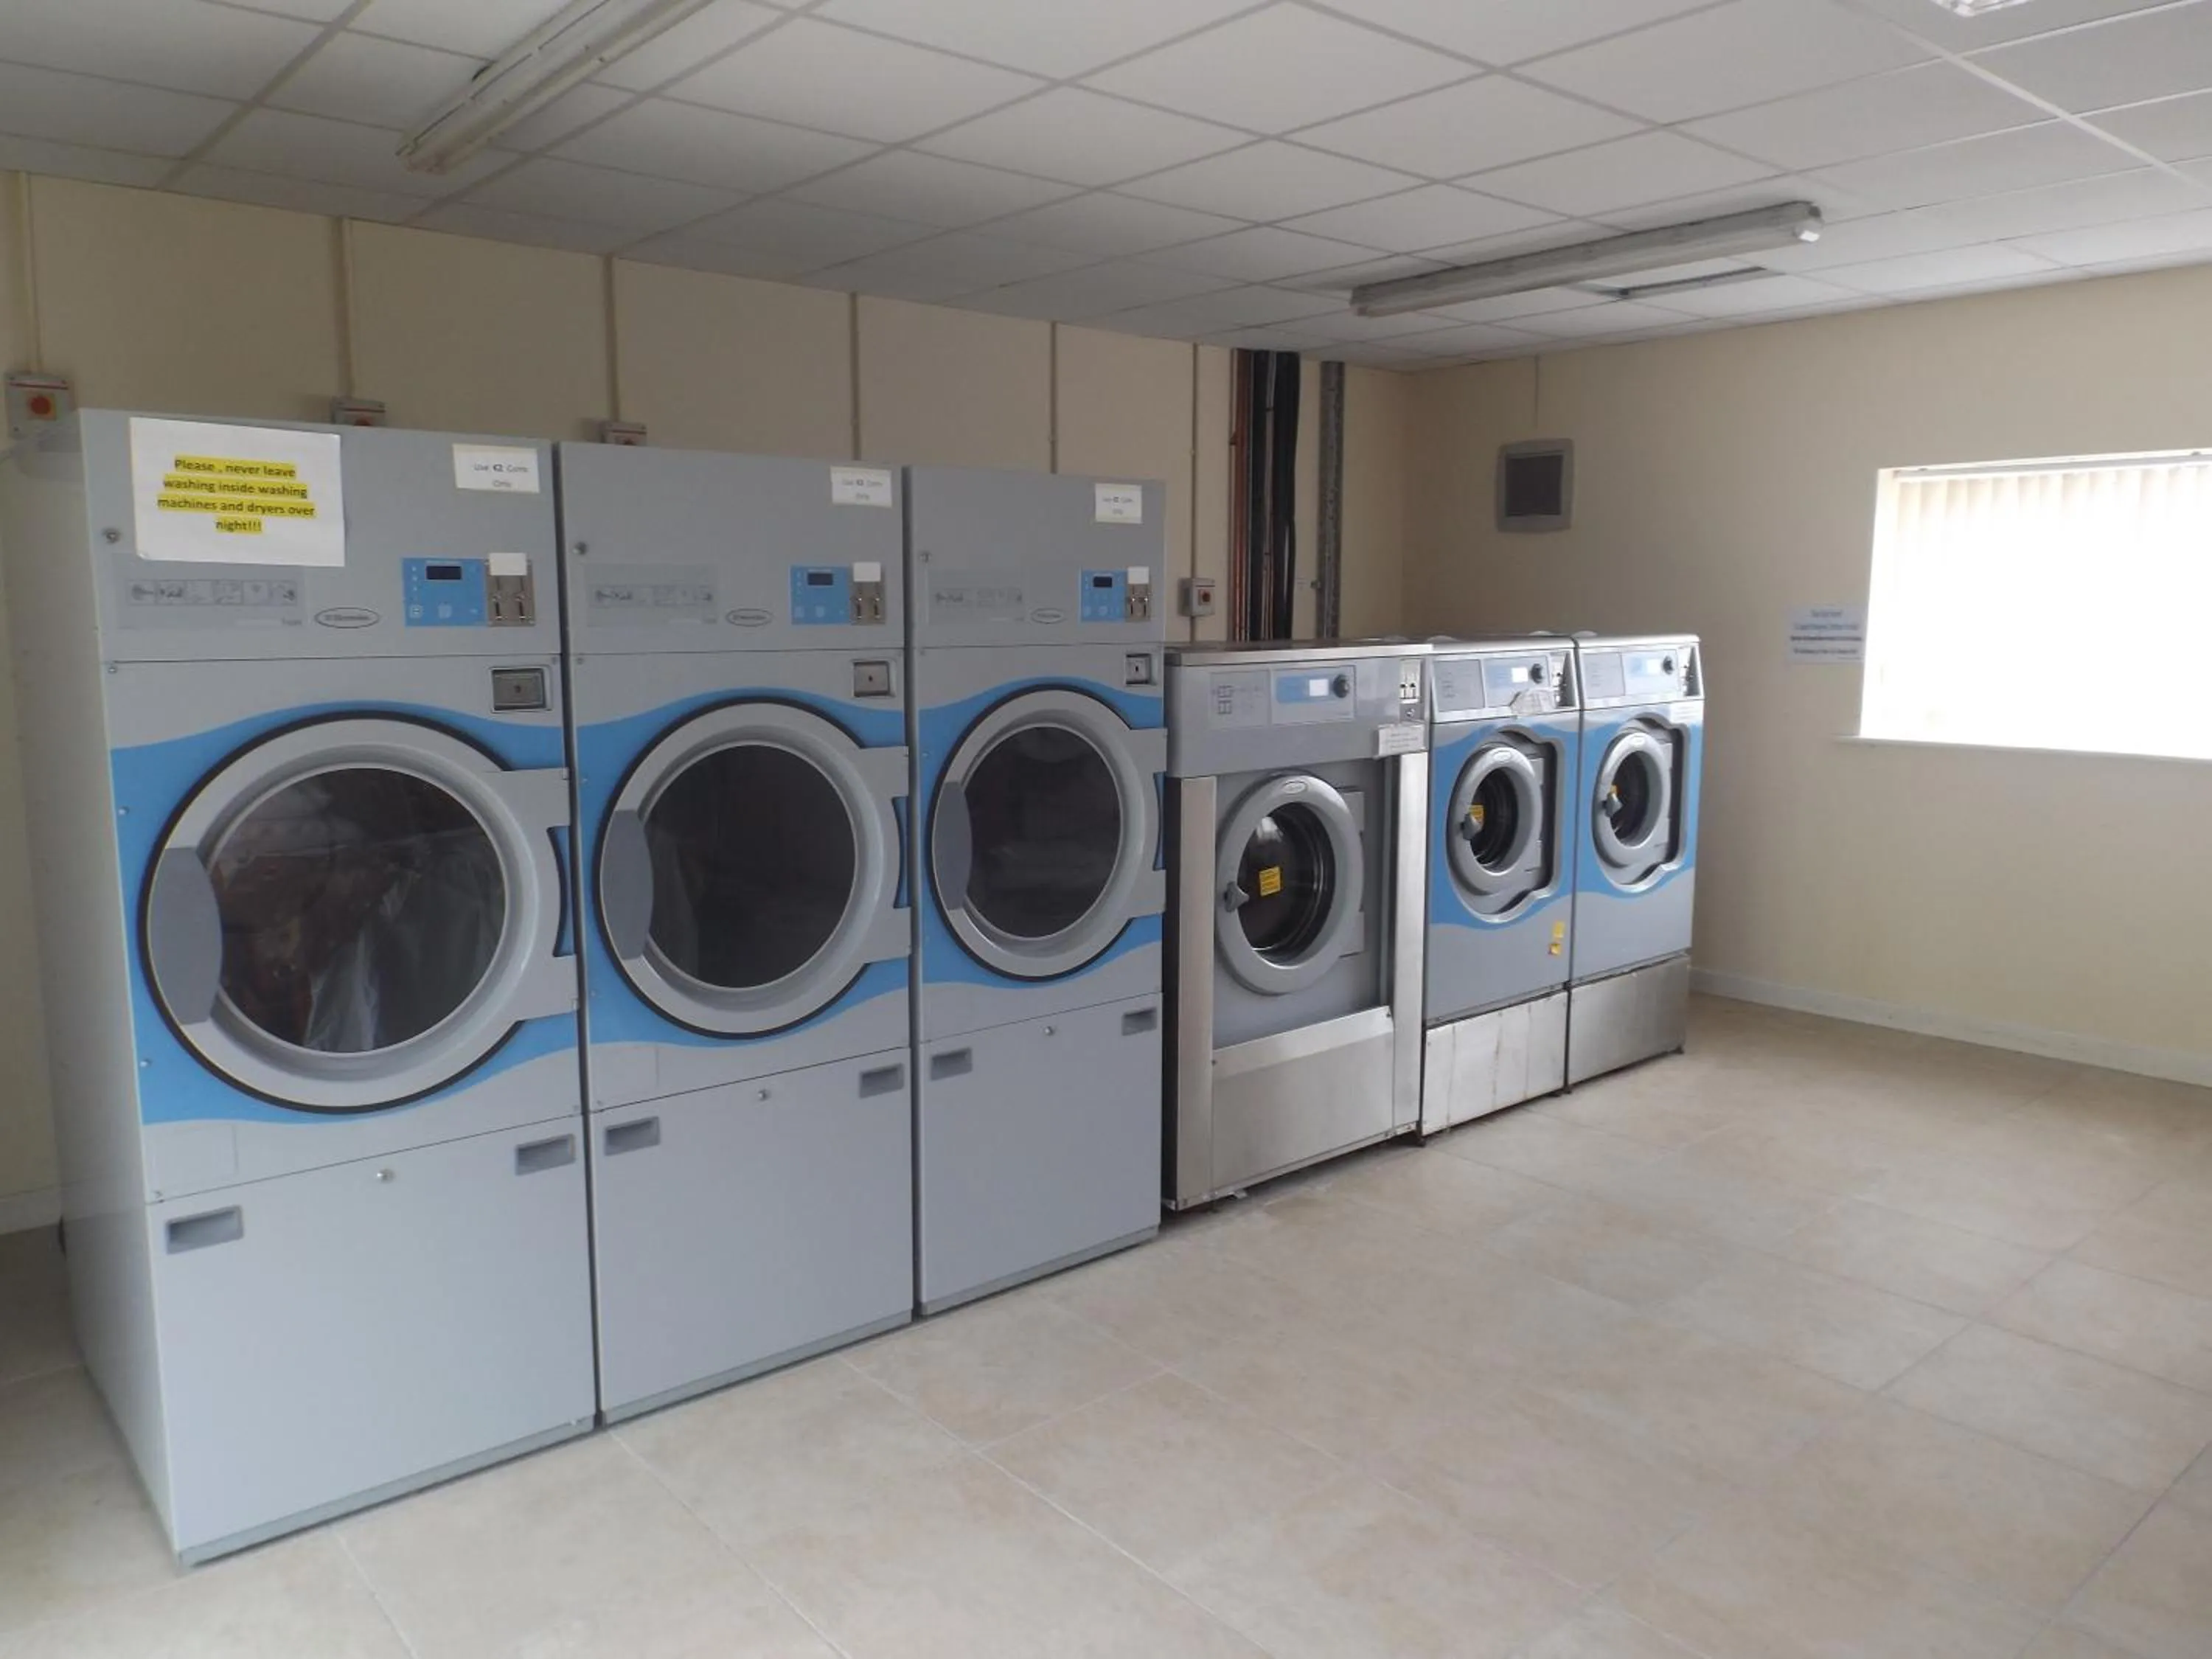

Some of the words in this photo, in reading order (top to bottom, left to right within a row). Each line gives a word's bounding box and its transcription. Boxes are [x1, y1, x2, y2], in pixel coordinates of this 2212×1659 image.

[174, 459, 215, 470] Please
[225, 465, 260, 474] never
[263, 465, 296, 477] leave
[163, 479, 216, 493] washing
[219, 482, 254, 493] inside
[258, 486, 307, 499] washing
[157, 498, 217, 509] machines
[220, 501, 244, 512] and
[247, 501, 285, 515] dryers
[288, 507, 316, 515] over
[215, 519, 262, 532] night!!!
